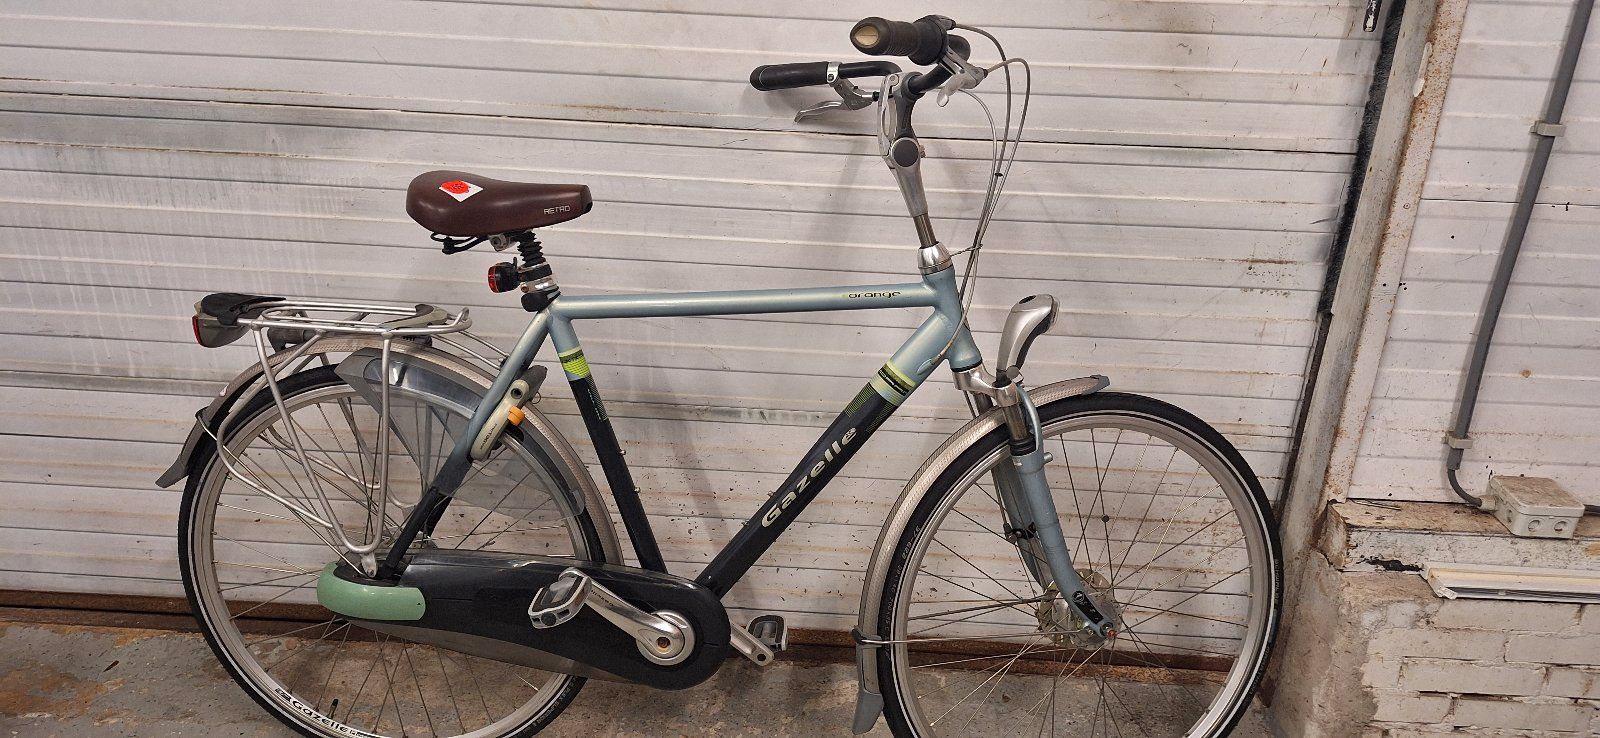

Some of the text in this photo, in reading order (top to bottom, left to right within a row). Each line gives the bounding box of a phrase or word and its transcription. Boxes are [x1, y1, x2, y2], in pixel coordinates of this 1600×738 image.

[543, 205, 571, 215] RETRO
[848, 291, 901, 299] orange
[762, 427, 857, 528] Gazelle
[293, 701, 348, 733] Gazelle
